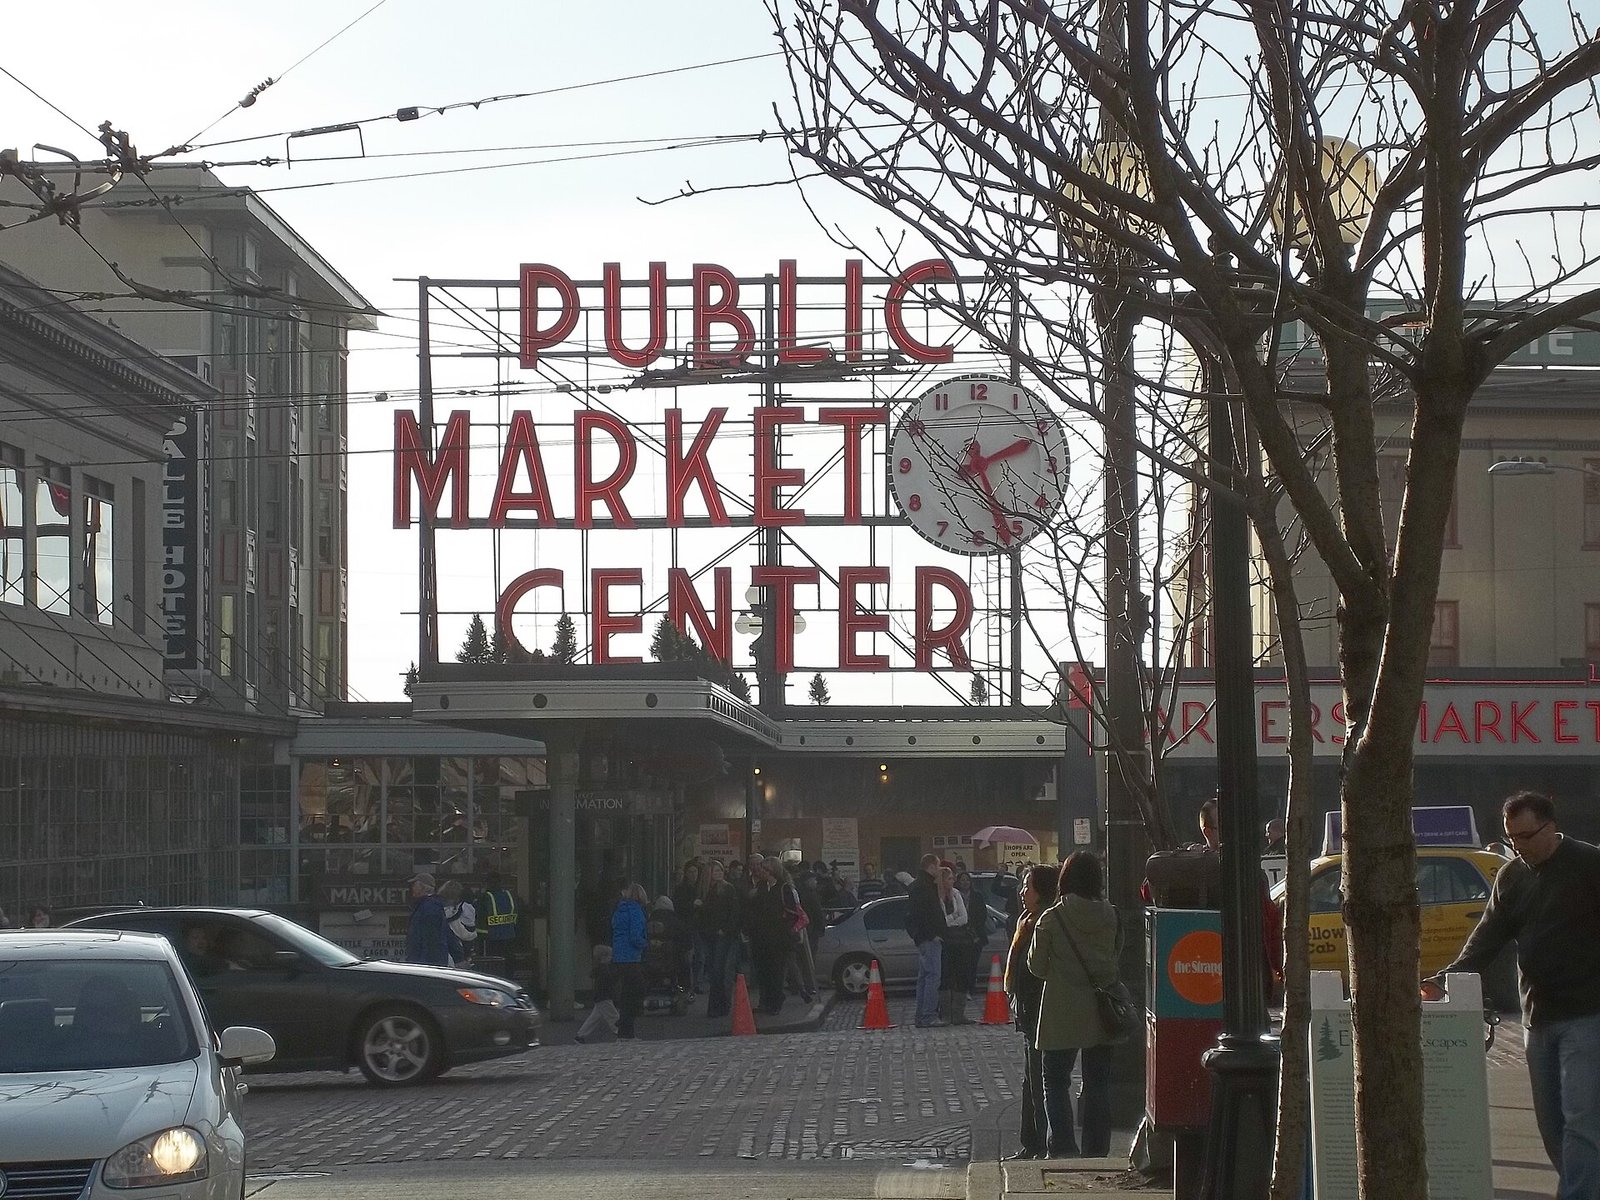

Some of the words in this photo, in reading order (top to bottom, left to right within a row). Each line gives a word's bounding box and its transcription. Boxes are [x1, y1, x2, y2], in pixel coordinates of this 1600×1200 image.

[519, 259, 954, 369] PUBLIC
[970, 383, 988, 401] 12
[935, 393, 949, 411] 11
[1012, 393, 1018, 410] 1
[393, 407, 888, 530] MARKET
[900, 457, 912, 474] 9
[909, 494, 922, 511] 8
[937, 521, 949, 537] 7
[1012, 520, 1024, 536] 5
[973, 530, 985, 547] 6
[496, 566, 973, 672] CENTER
[1142, 701, 1345, 744] ARERS
[1419, 701, 1600, 744] ARKET
[538, 798, 623, 809] INMATION
[330, 887, 408, 905] MARKET
[1308, 927, 1345, 940] ellow
[1191, 960, 1222, 976] Strang
[1421, 1038, 1468, 1051] scapes
